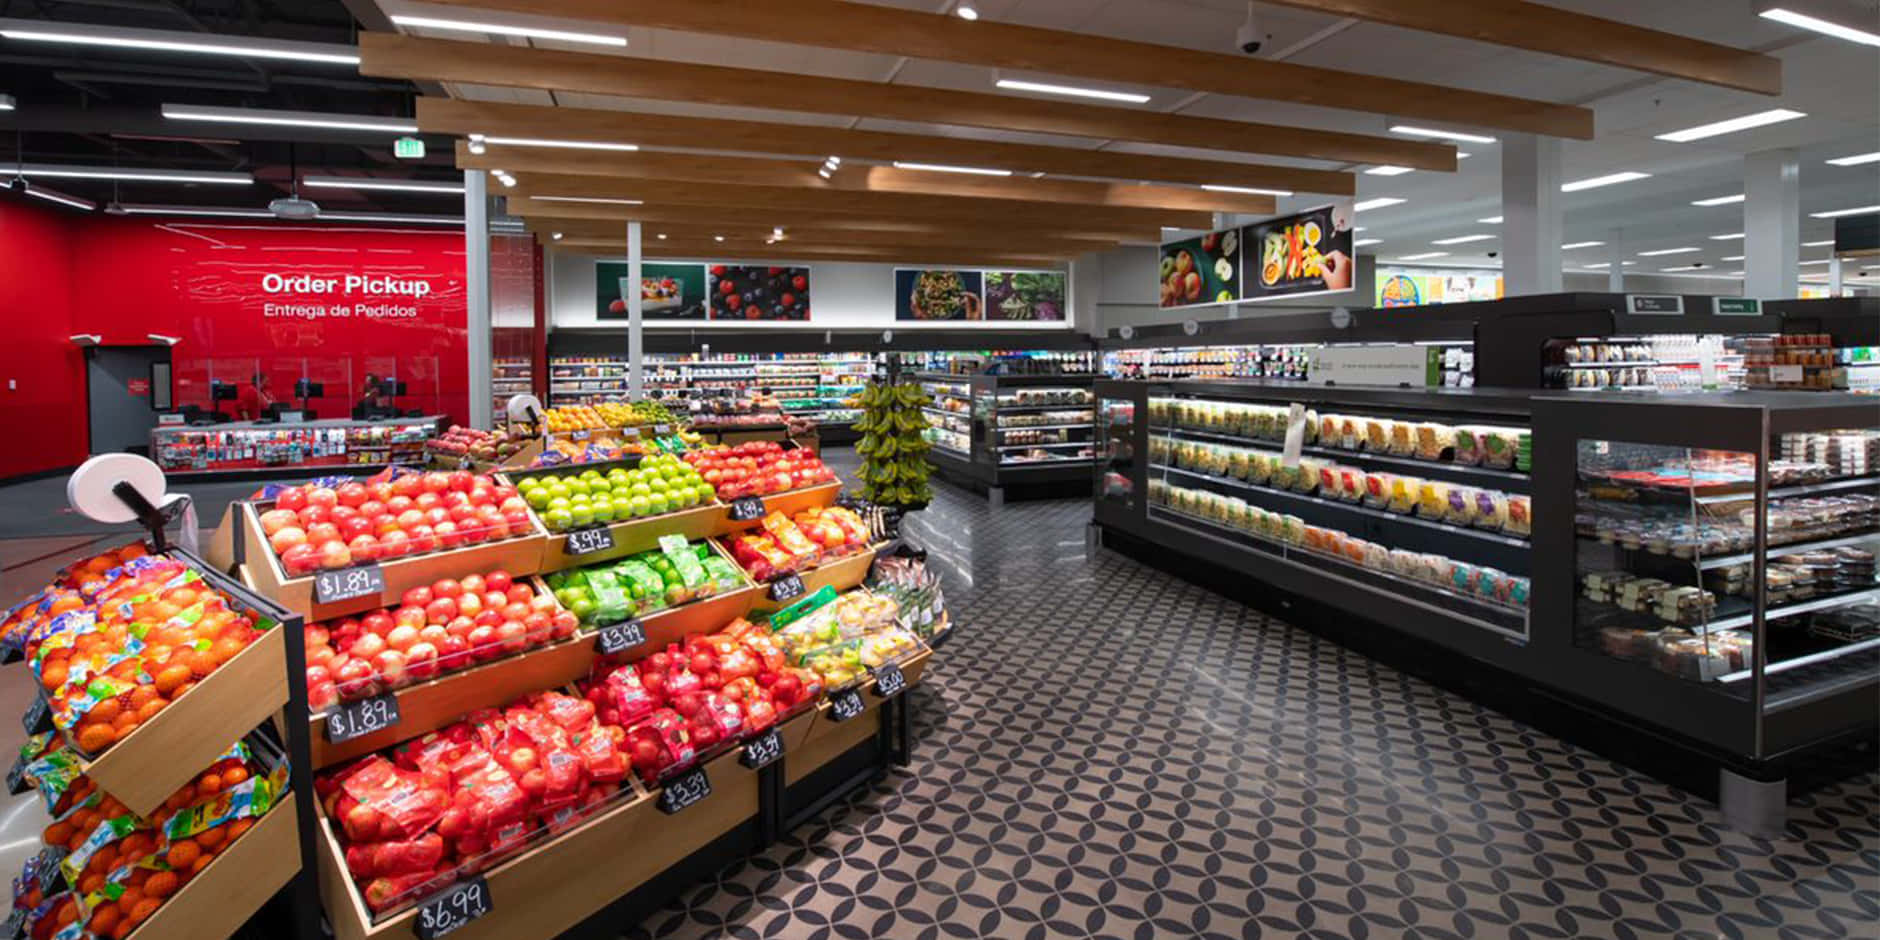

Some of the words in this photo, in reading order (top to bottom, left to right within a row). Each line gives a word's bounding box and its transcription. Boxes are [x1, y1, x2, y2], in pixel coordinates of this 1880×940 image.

[262, 273, 338, 293] Order
[345, 275, 430, 298] Pickup
[263, 303, 326, 319] Entrega
[330, 304, 350, 317] de
[354, 304, 417, 317] Pedidos
[320, 570, 369, 595] $1.89
[331, 700, 388, 735] $1.89
[665, 772, 707, 803] $3.39
[422, 884, 482, 929] $6.99
